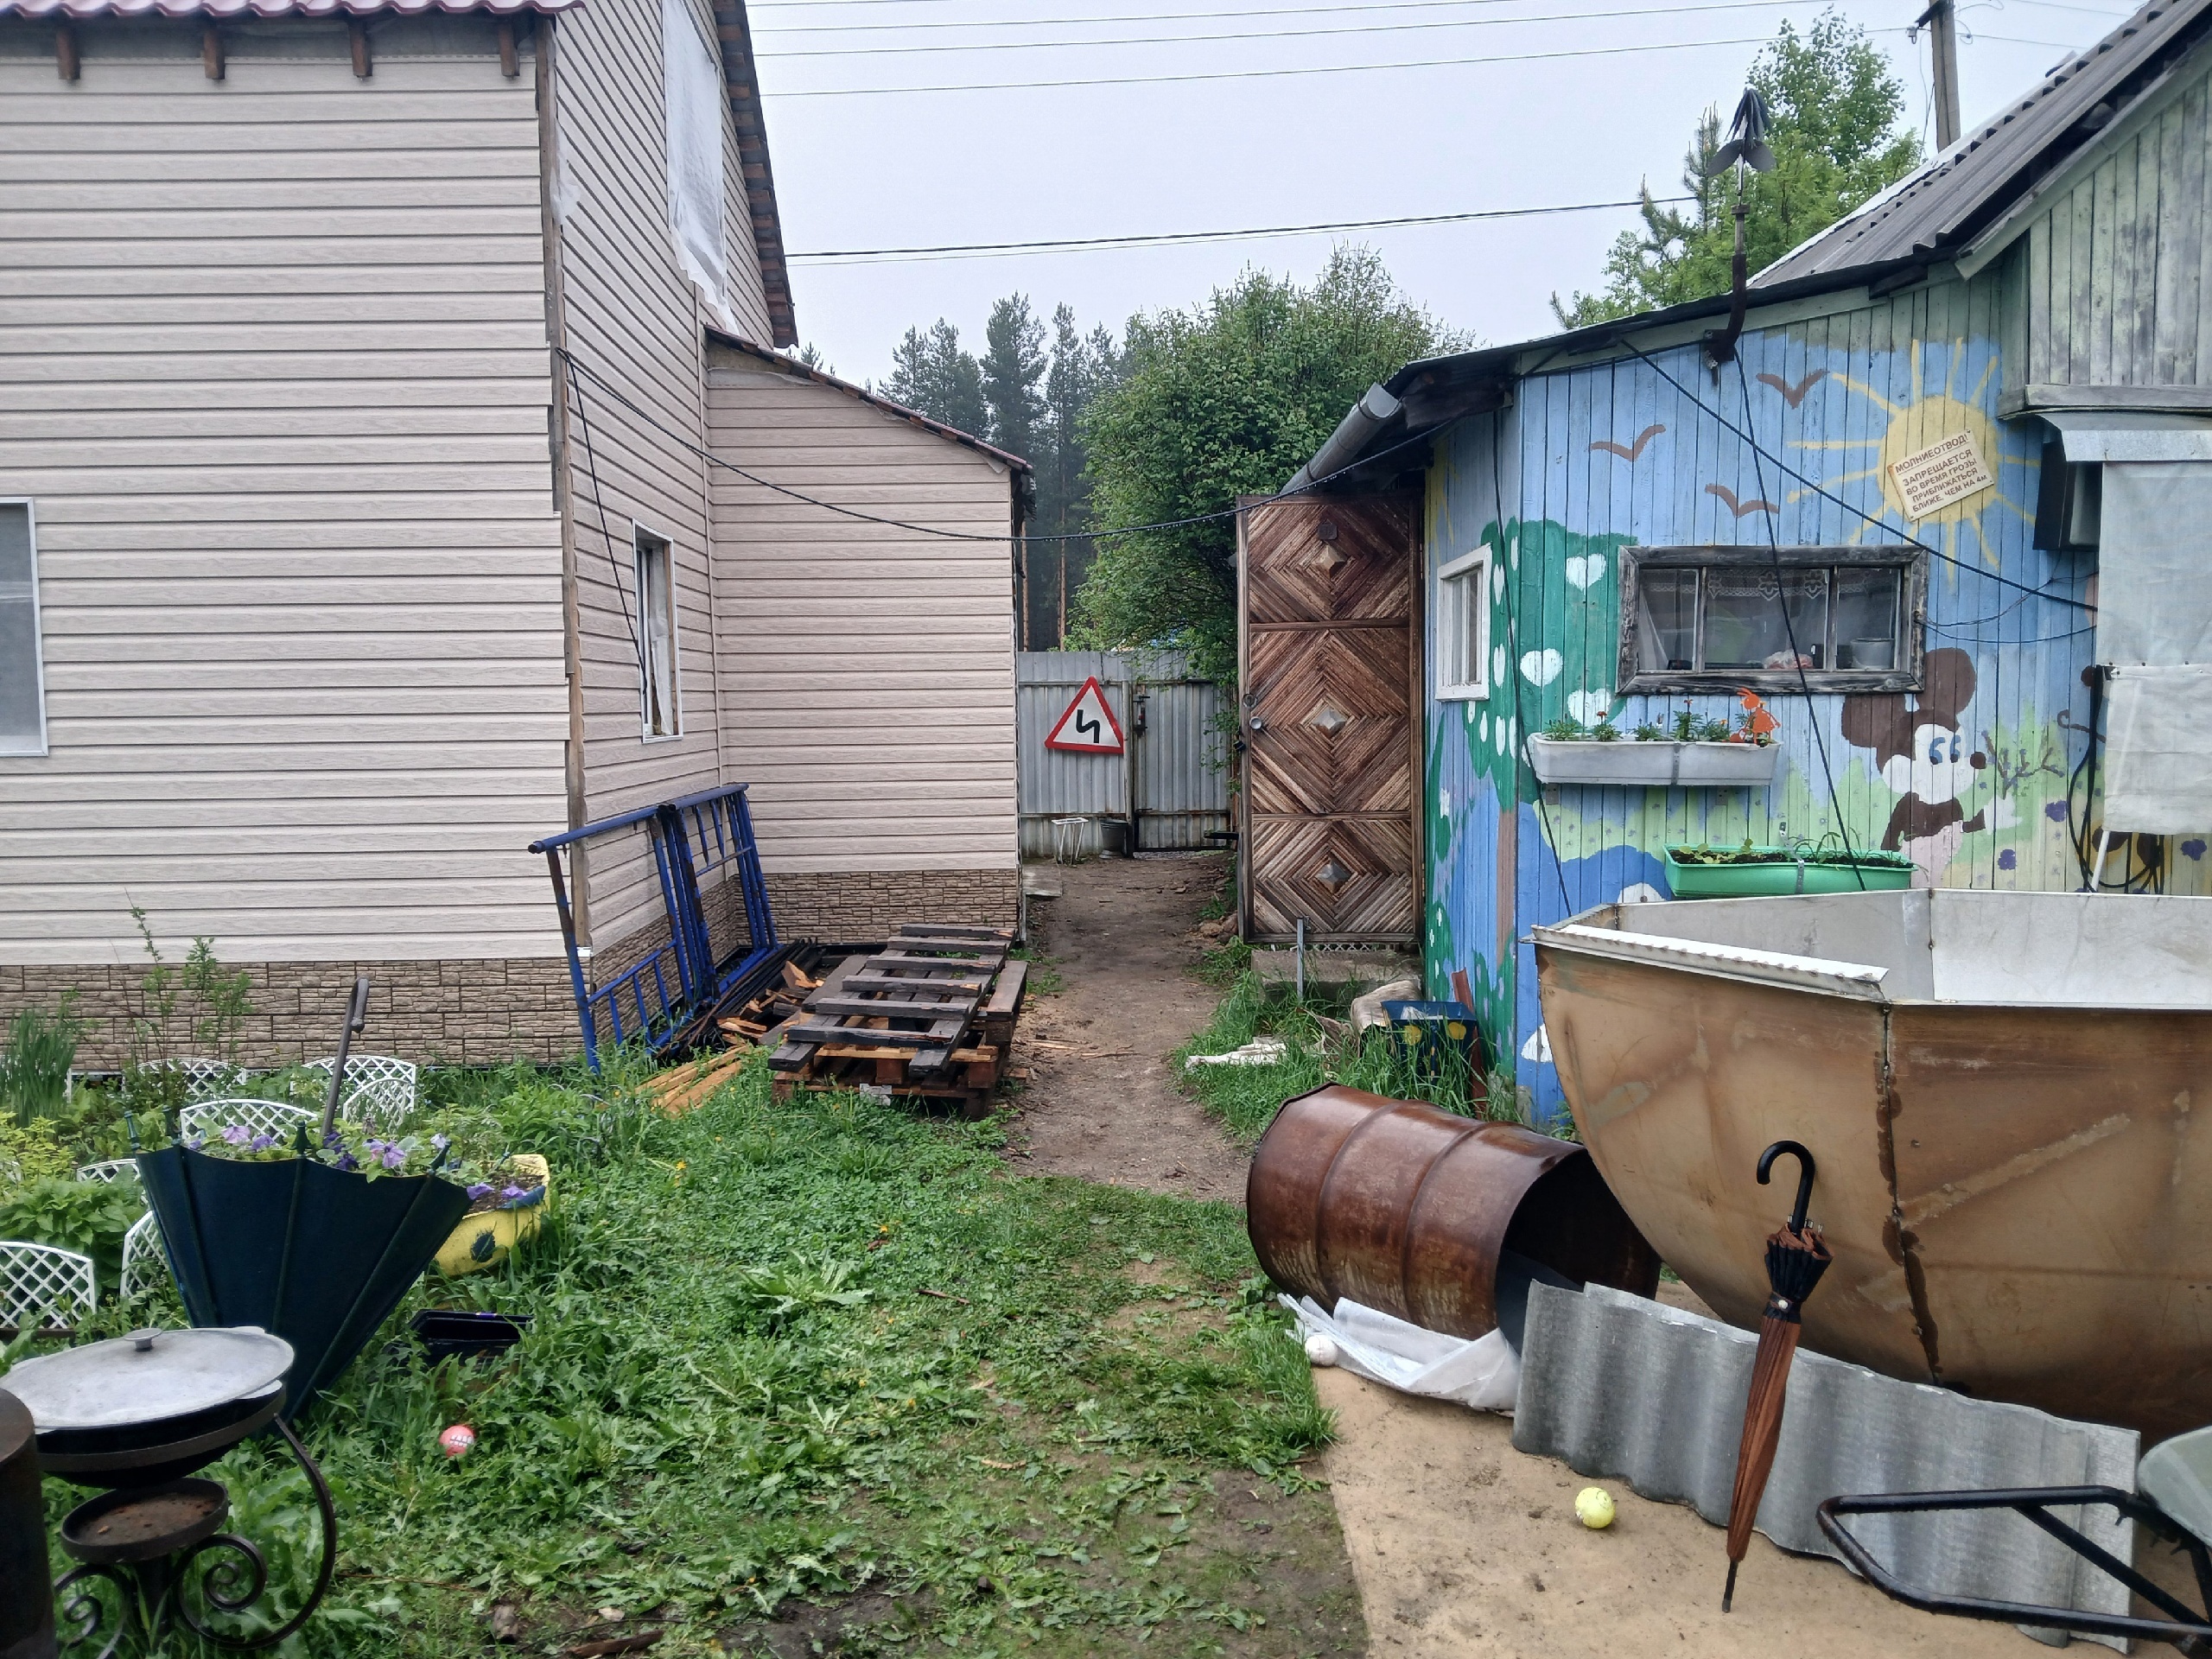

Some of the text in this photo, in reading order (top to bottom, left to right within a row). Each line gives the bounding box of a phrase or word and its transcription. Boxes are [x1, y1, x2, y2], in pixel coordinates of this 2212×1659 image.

[1895, 434, 1968, 473] МОЛНИЕОТВОД!
[1903, 449, 1972, 486] ЗАПРЕЩАЕТСЯ
[1905, 459, 1977, 495] ВО ВРЕМЯ ГРОЗЫ
[1913, 467, 1978, 502] ПРИБЛИЖАТЬСЯ
[1945, 485, 1962, 496] ЧЕМ
[1963, 480, 1975, 489] НА
